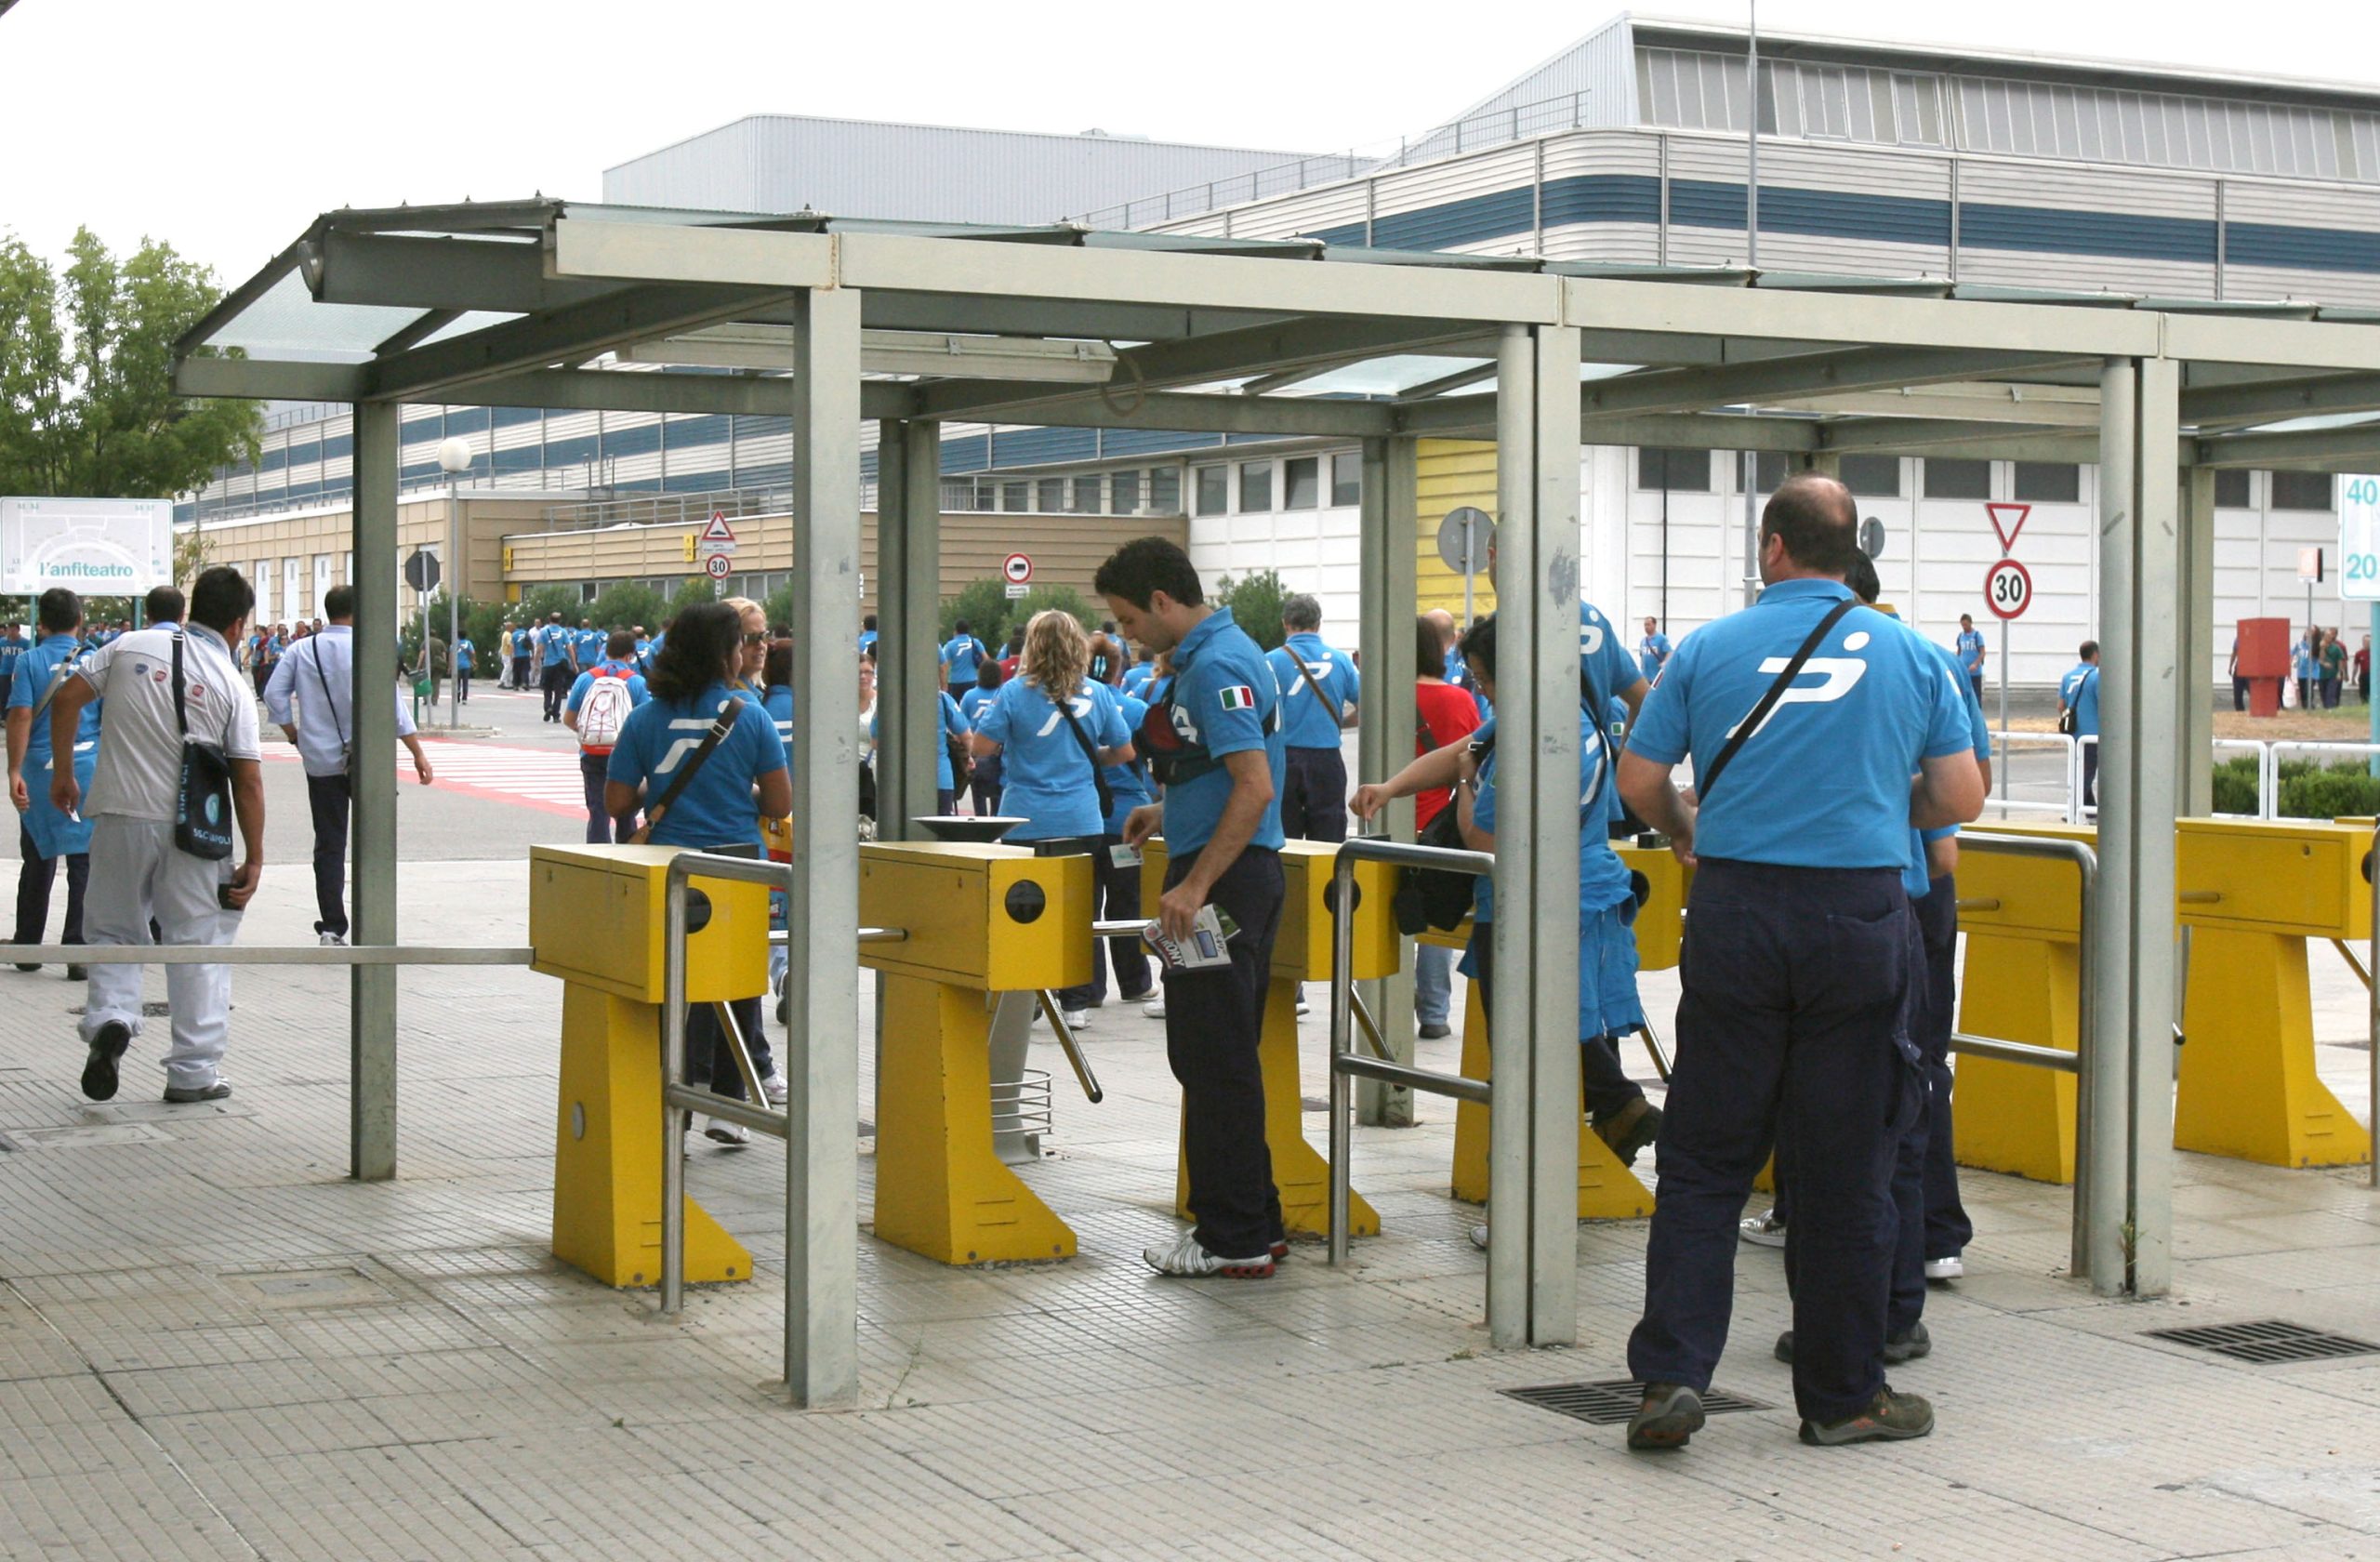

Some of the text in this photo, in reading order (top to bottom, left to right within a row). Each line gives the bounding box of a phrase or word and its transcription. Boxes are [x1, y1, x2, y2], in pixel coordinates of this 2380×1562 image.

[2347, 479, 2378, 505] 40
[40, 562, 133, 576] l'anfiteatro
[711, 561, 726, 573] 30
[2346, 553, 2378, 579] 20
[1995, 574, 2023, 602] 30
